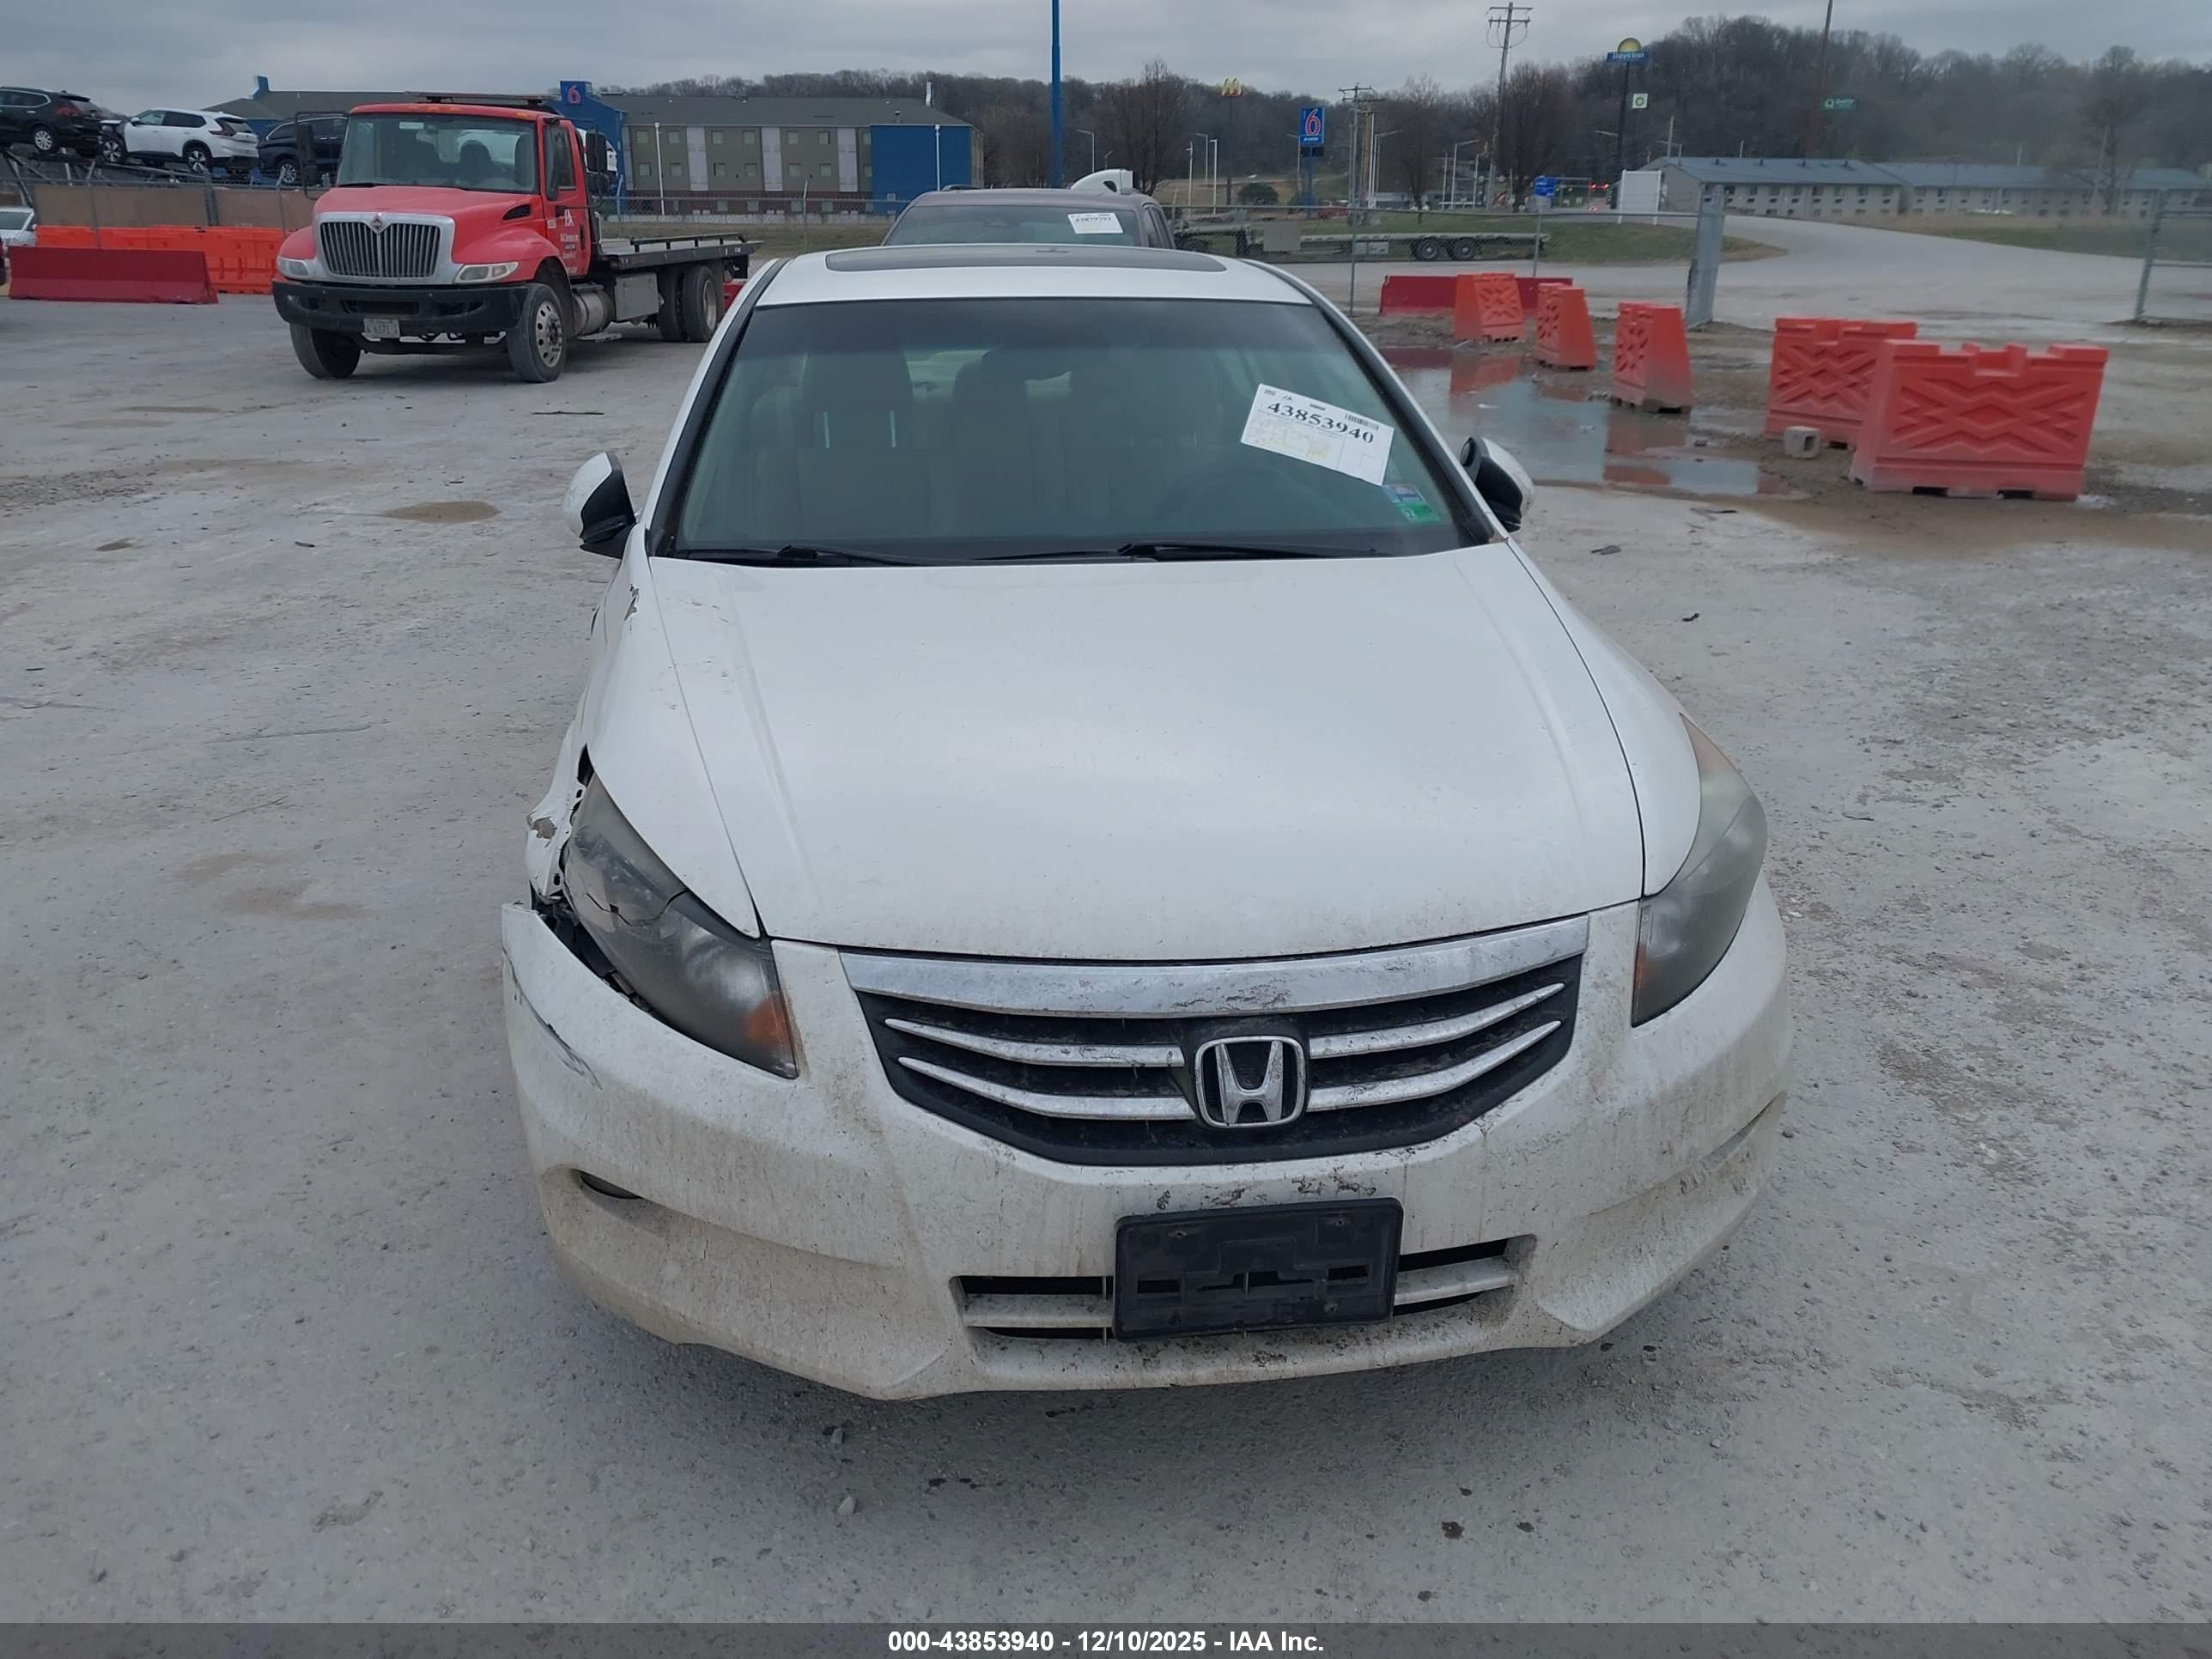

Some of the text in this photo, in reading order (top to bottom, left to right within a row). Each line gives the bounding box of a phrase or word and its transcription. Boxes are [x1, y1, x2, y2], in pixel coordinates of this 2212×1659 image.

[568, 84, 581, 104] 6
[1305, 108, 1322, 137] 6
[1267, 402, 1374, 444] 43853940
